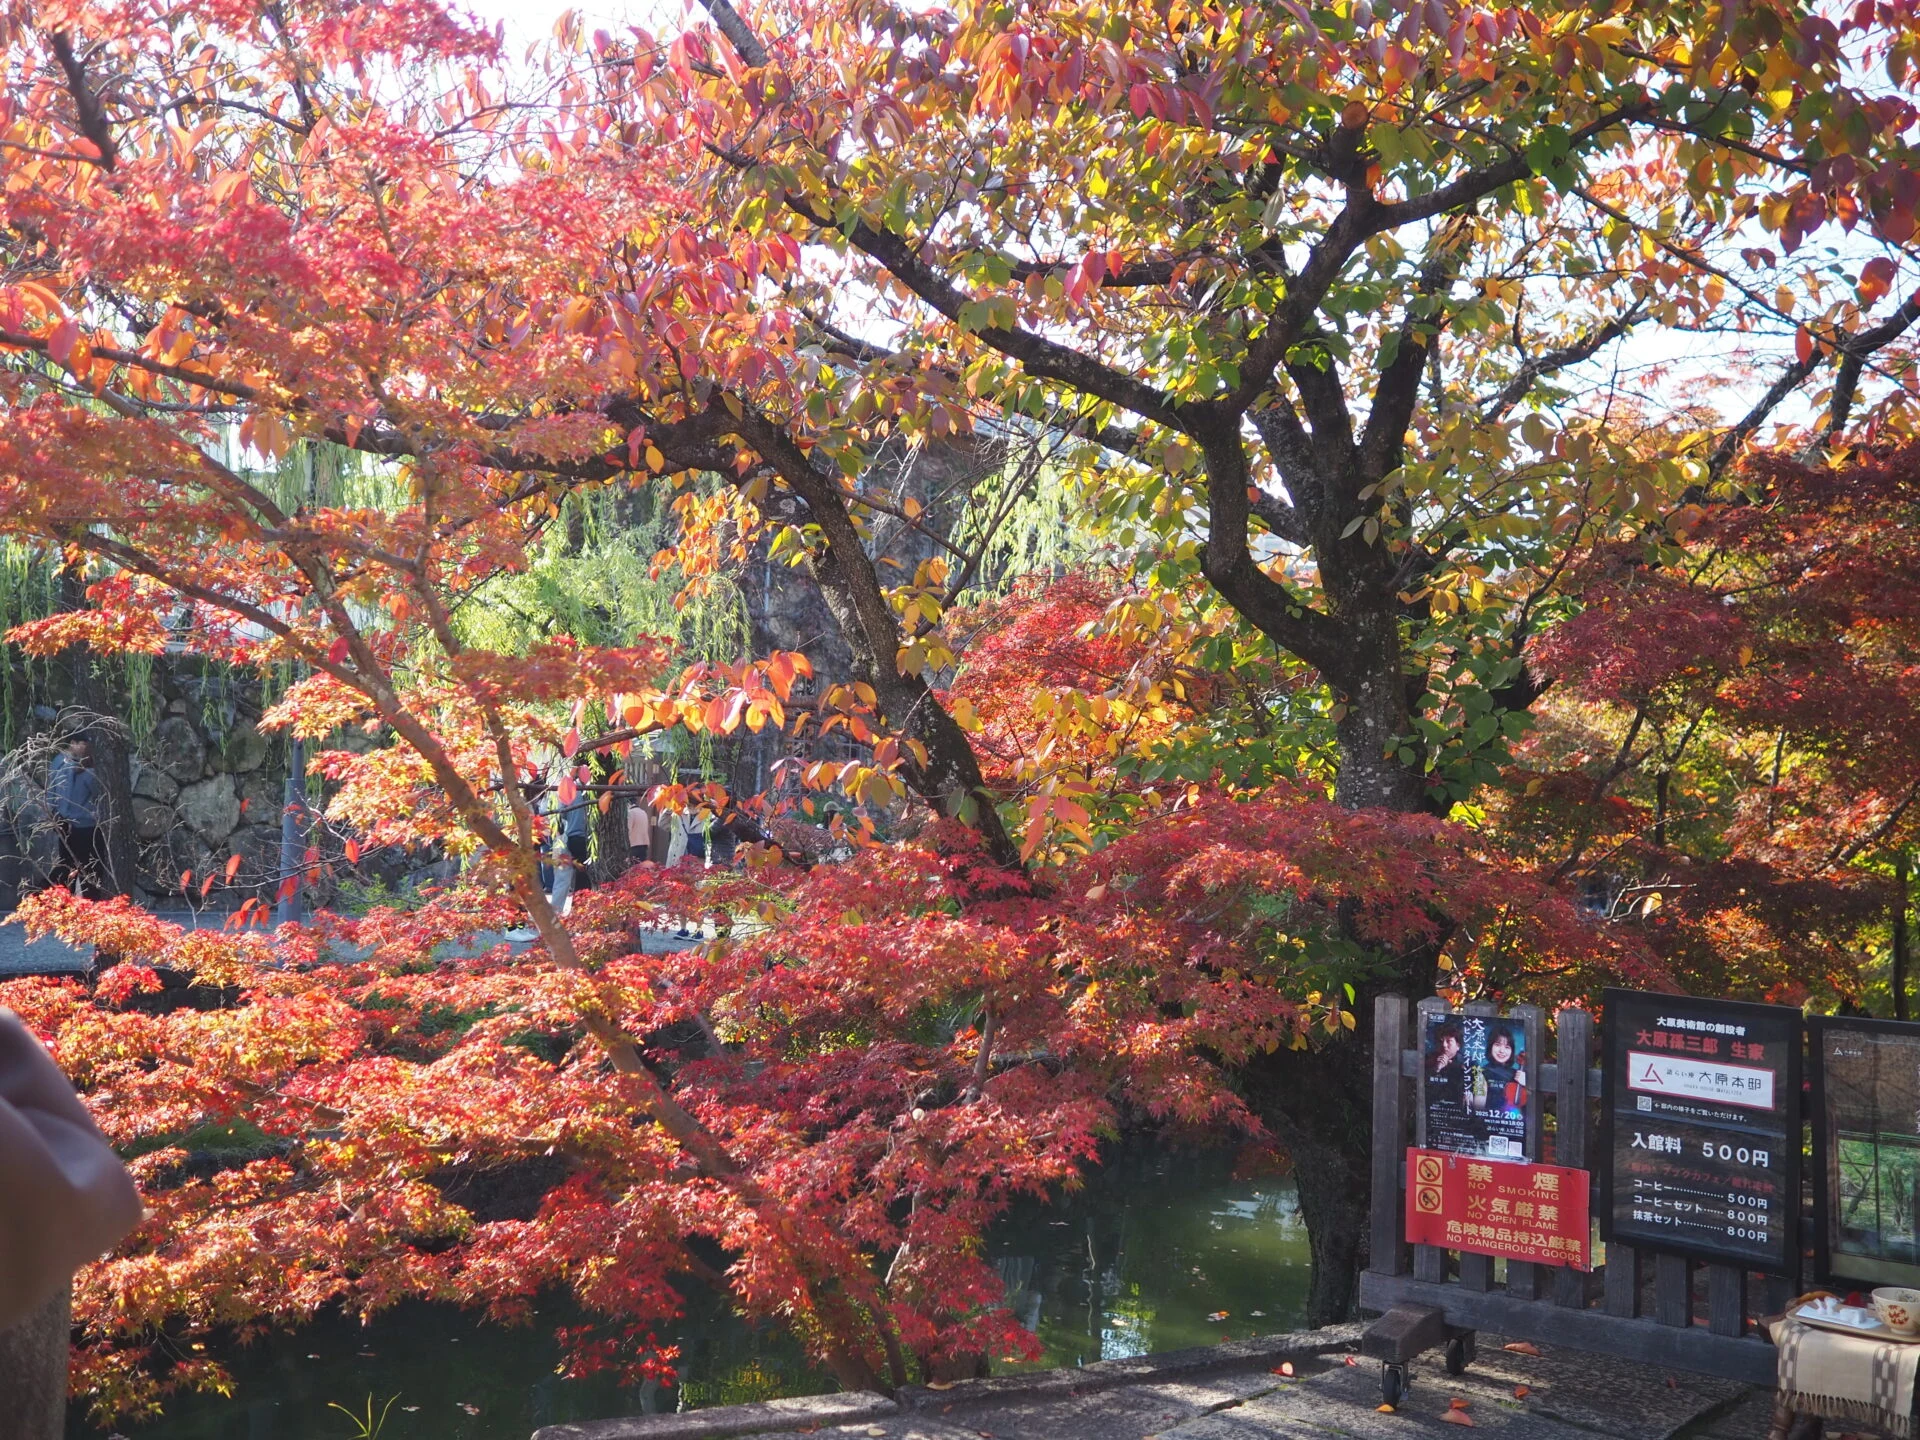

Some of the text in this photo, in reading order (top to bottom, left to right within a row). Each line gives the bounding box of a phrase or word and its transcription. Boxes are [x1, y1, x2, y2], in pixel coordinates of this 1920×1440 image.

[1656, 1016, 1746, 1037] 大原美術館の創設者
[1636, 1029, 1765, 1061] 大原孫三郎 生家
[1699, 1071, 1762, 1091] 大原本邸
[1631, 1132, 1769, 1167] 入館料 500円
[1468, 1182, 1560, 1200] NO SMOKING
[1467, 1195, 1560, 1222] 火気厳禁
[1727, 1193, 1768, 1210] 500円
[1467, 1211, 1559, 1231] NO OPEN FLAME
[1727, 1209, 1768, 1226] 800円
[1447, 1220, 1582, 1253] 危険物品持込厳禁
[1727, 1226, 1768, 1243] 800円
[1446, 1233, 1582, 1263] NO DANGEROUS GOODS
